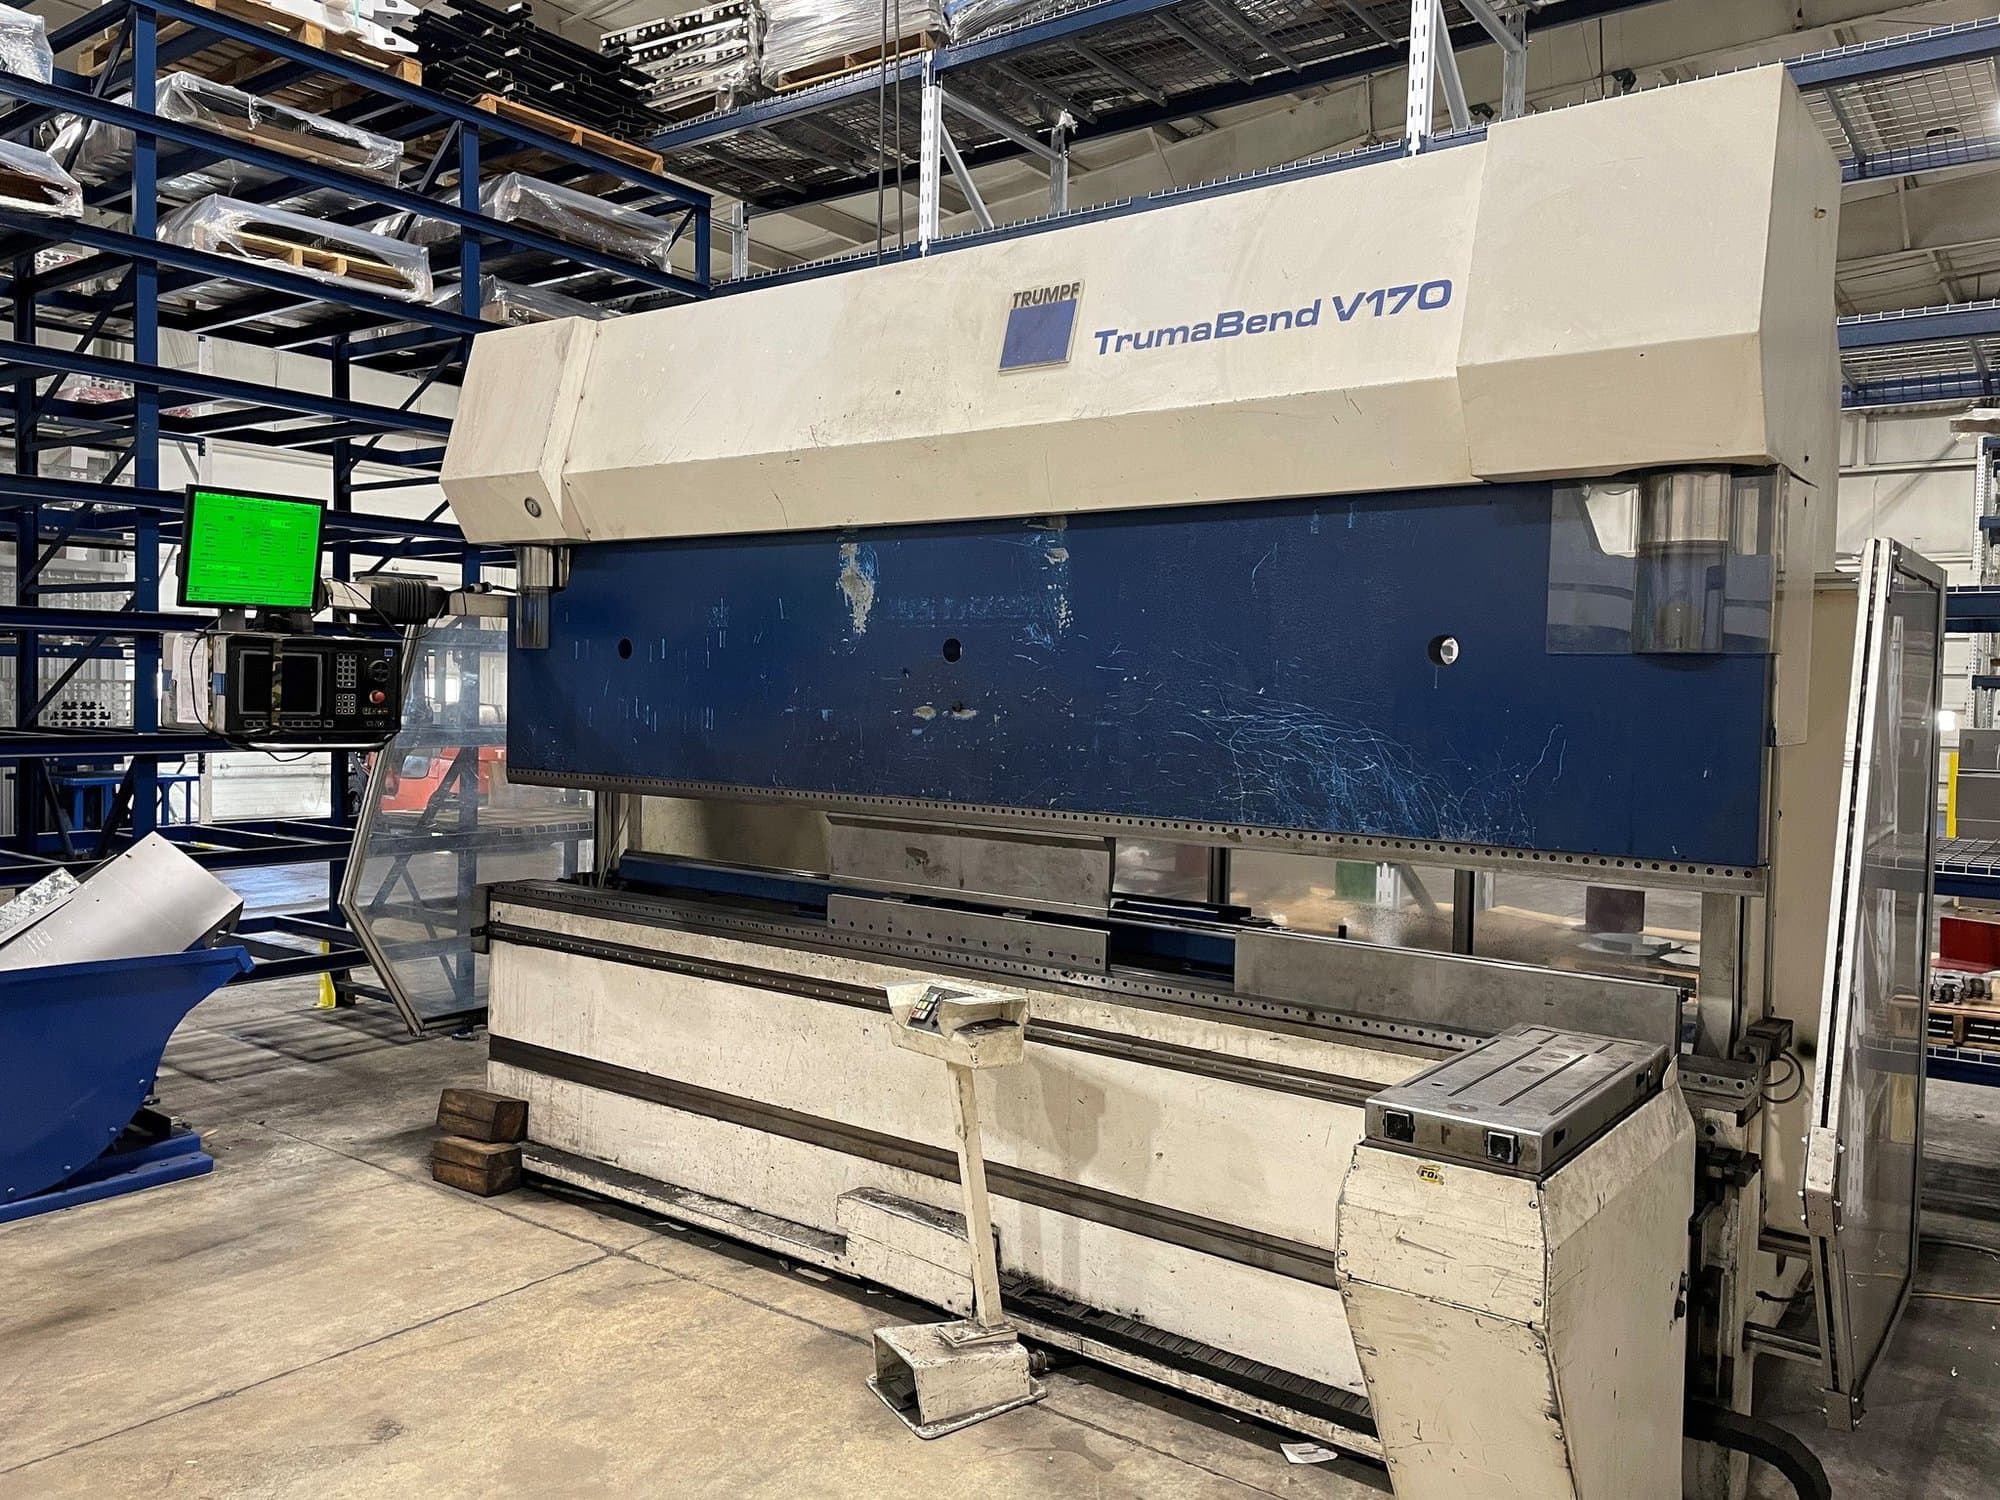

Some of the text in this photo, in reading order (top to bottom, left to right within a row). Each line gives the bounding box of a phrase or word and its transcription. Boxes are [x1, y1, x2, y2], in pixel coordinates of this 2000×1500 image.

[1013, 282, 1080, 308] TRUMPF
[1094, 279, 1453, 355] TrumaBend V170
